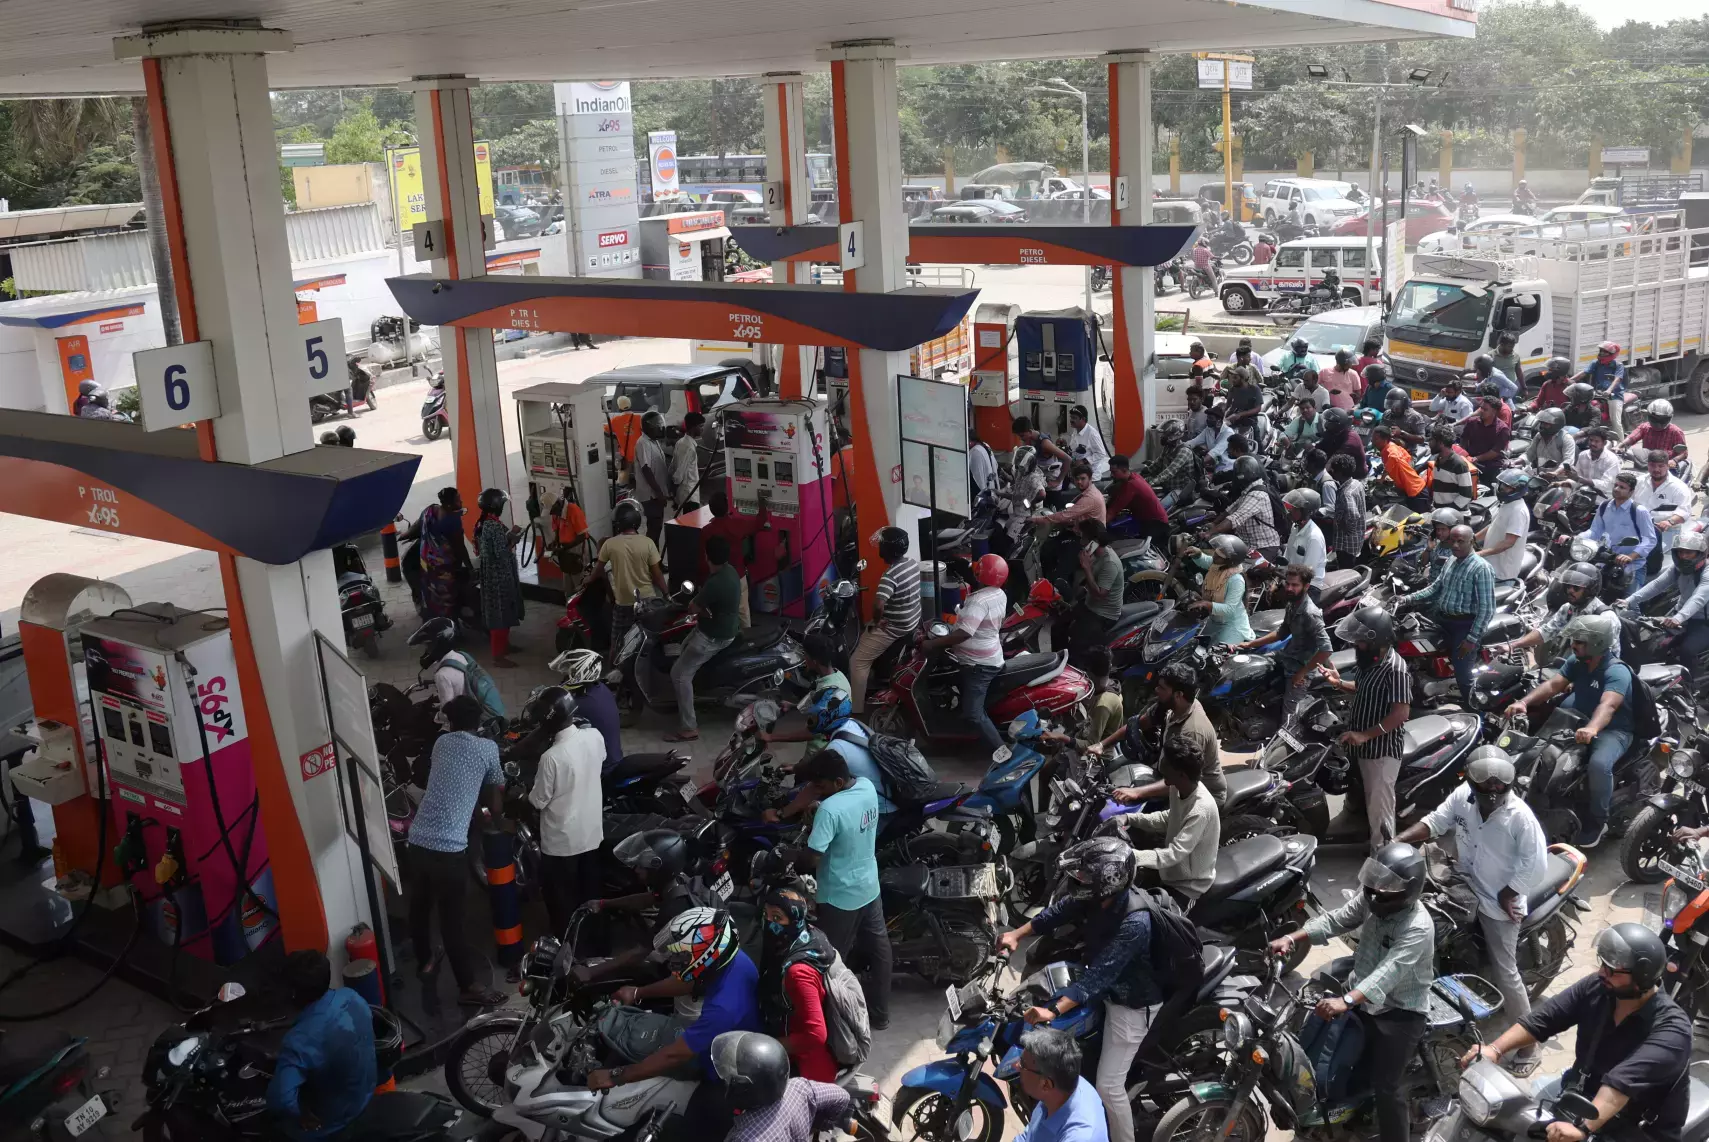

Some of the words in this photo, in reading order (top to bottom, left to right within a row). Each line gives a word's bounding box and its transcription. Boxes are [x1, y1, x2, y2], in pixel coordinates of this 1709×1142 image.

[576, 96, 630, 112] IndianOil
[768, 188, 774, 204] 2
[1120, 182, 1124, 202] 2
[424, 230, 434, 252] 4
[600, 233, 625, 246] SERVO
[848, 231, 856, 258] 4
[729, 313, 763, 324] PETROL
[733, 324, 761, 338] XP95
[68, 340, 80, 348] AIR
[306, 336, 328, 380] 5
[164, 364, 190, 410] 6
[86, 504, 120, 527] XP95
[198, 676, 234, 744] XP95
[323, 744, 333, 757] NO
[75, 1113, 85, 1123] TN
[86, 1106, 94, 1115] 10
